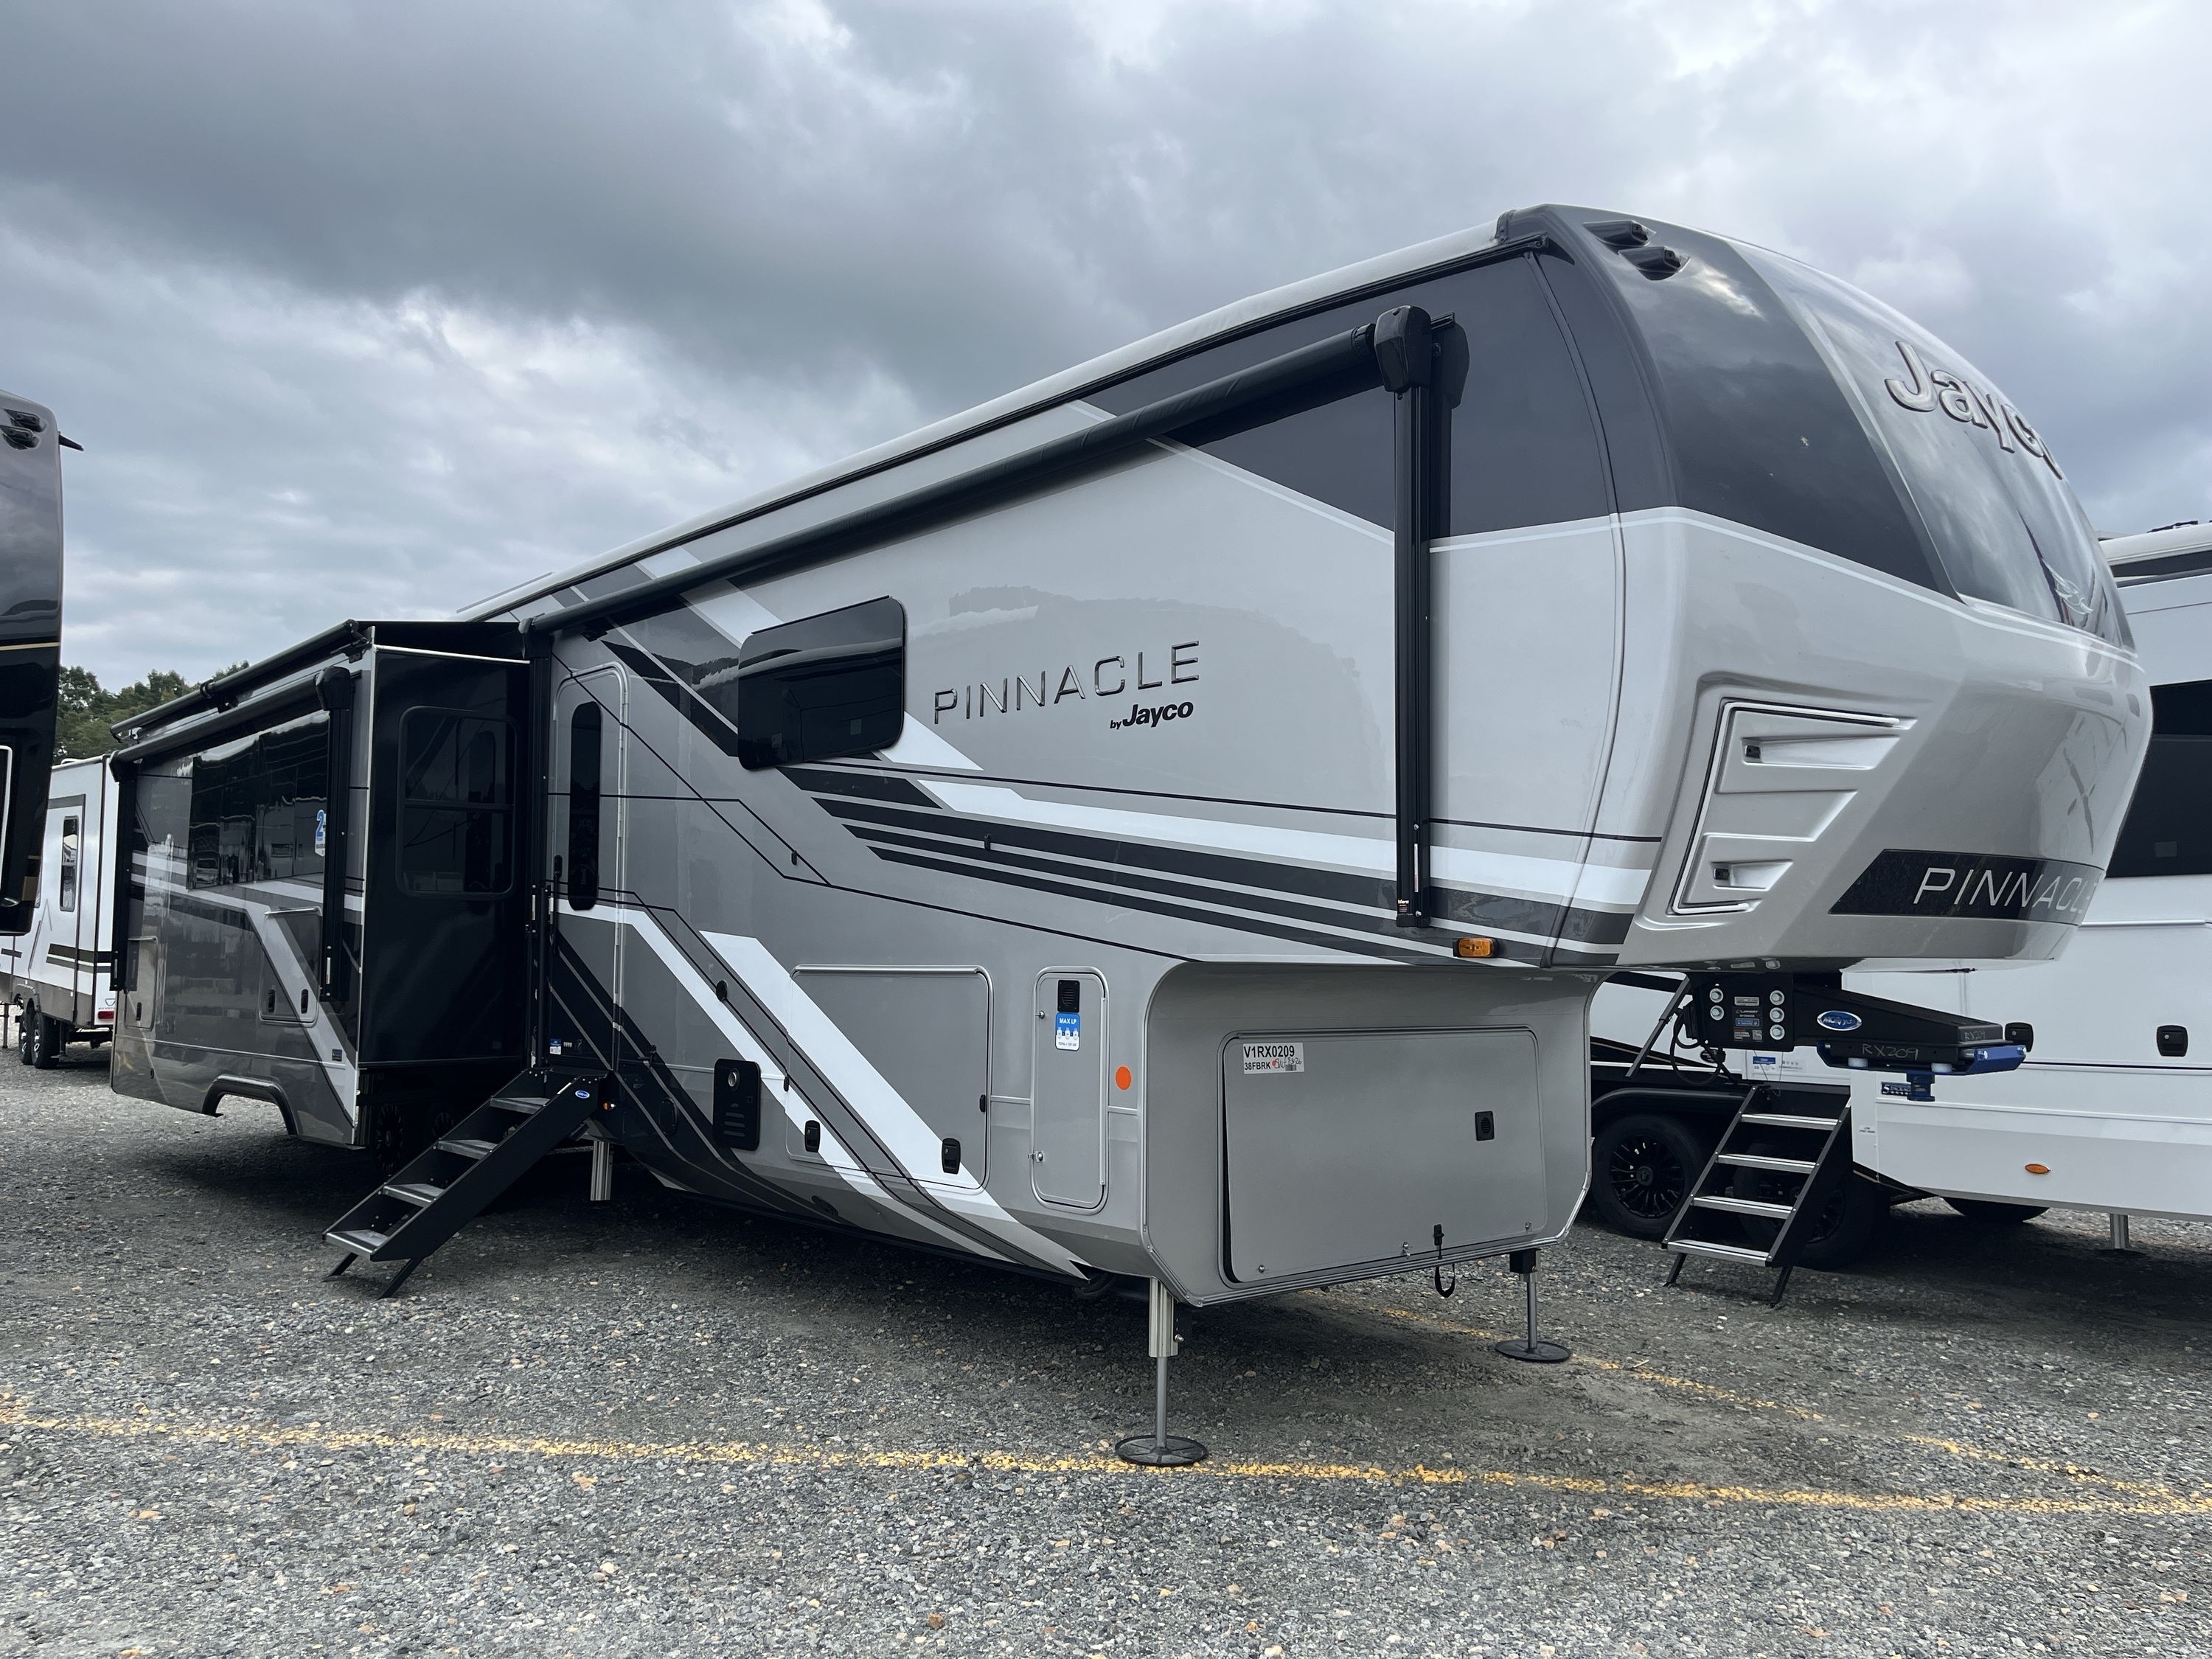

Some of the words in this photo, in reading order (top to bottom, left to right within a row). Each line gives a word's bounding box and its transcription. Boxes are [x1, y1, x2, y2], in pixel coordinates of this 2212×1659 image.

[934, 640, 1200, 725] PINNACLE
[1110, 720, 1122, 730] by
[1122, 701, 1194, 728] Jayco
[1244, 1046, 1295, 1057] V1RX0209
[1862, 1043, 1919, 1060] RX209
[1245, 1062, 1271, 1070] 38FBRK
